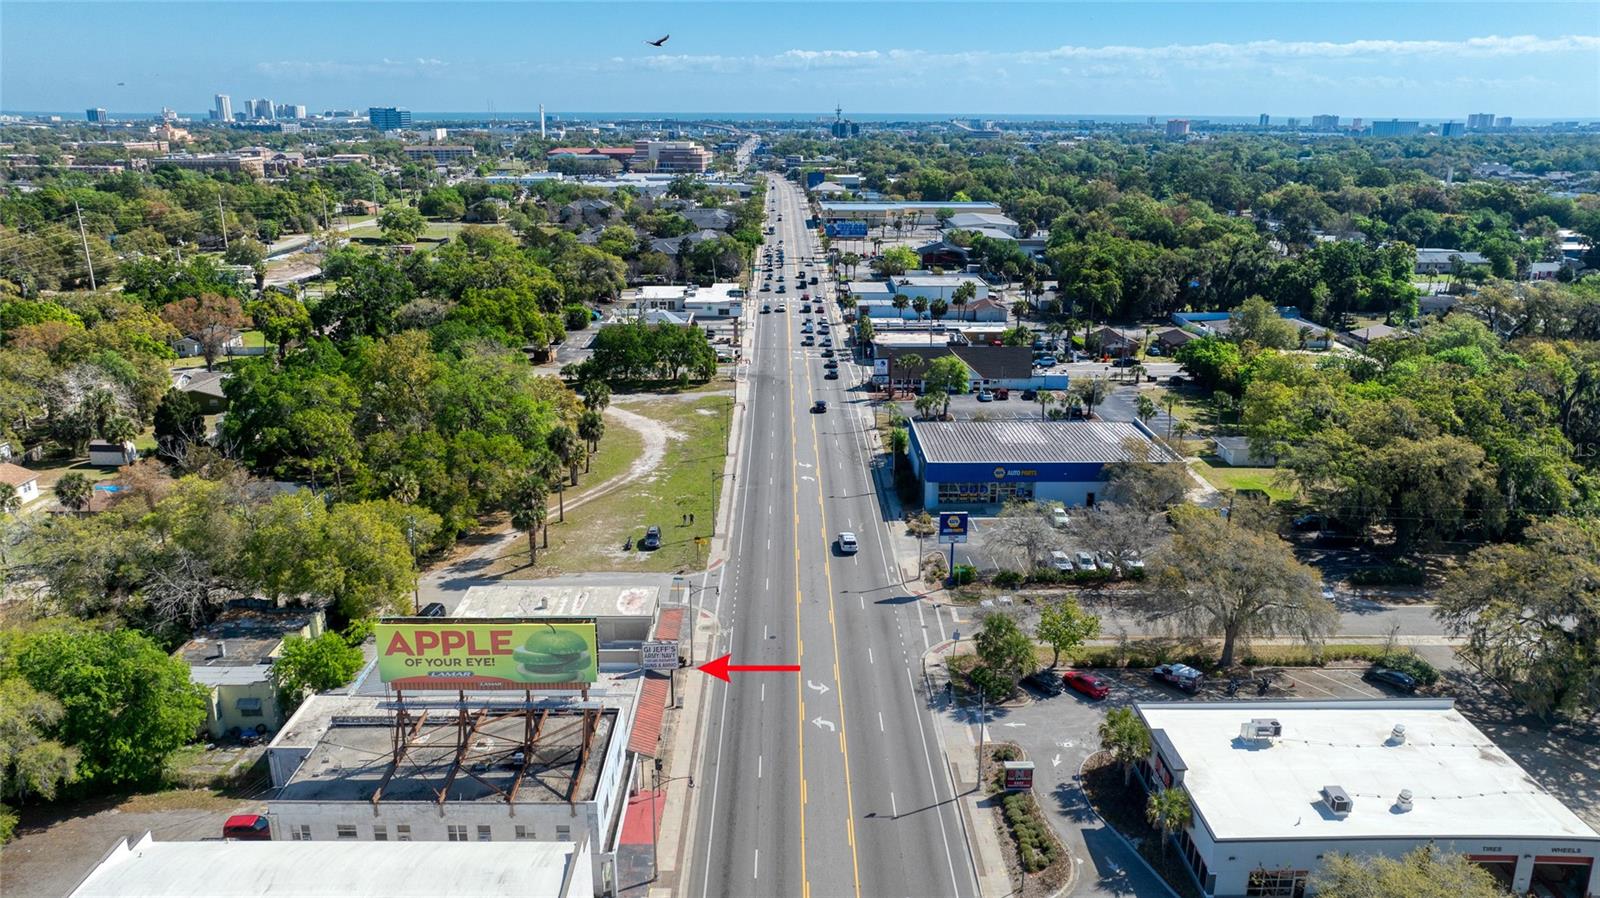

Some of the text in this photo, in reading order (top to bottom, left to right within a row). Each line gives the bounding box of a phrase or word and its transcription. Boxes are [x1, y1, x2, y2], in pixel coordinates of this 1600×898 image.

[384, 630, 514, 656] APPLE
[405, 658, 495, 667] OF YOUR EYE!
